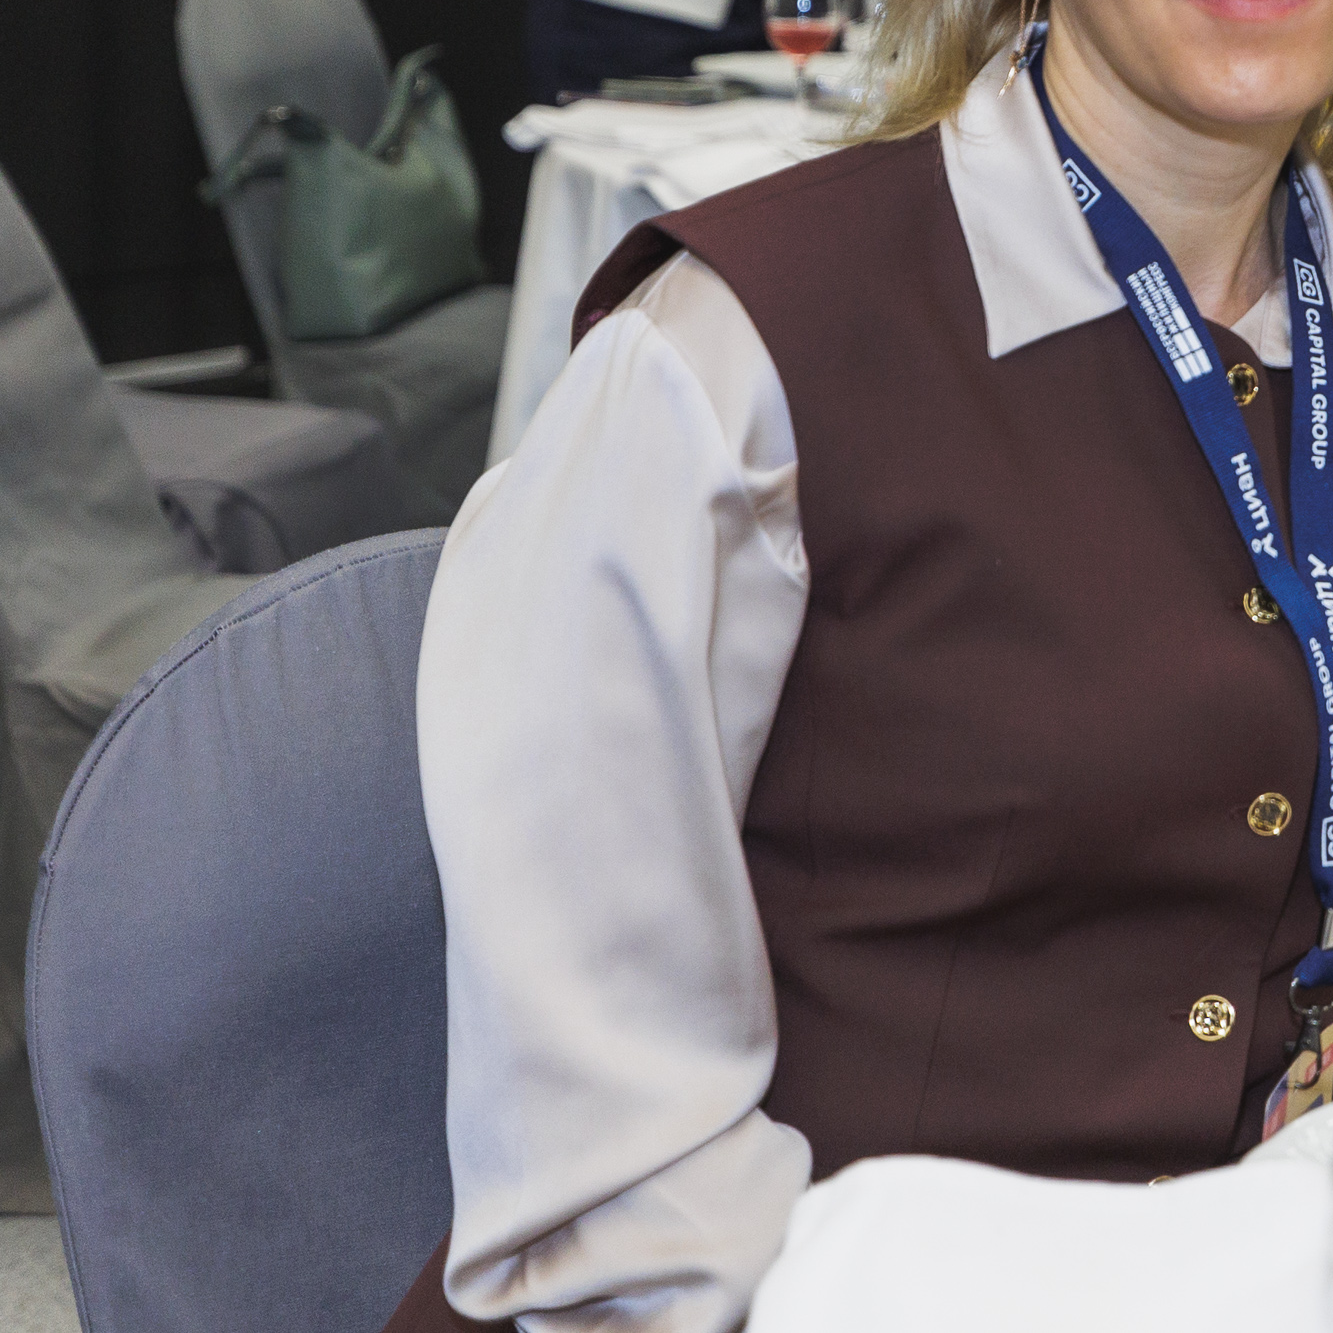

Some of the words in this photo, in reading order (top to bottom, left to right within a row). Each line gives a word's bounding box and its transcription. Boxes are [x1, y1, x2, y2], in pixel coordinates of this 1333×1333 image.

[1305, 307, 1328, 390] CAPITAL
[1311, 393, 1328, 470] GROUP
[1230, 452, 1270, 532] циан
